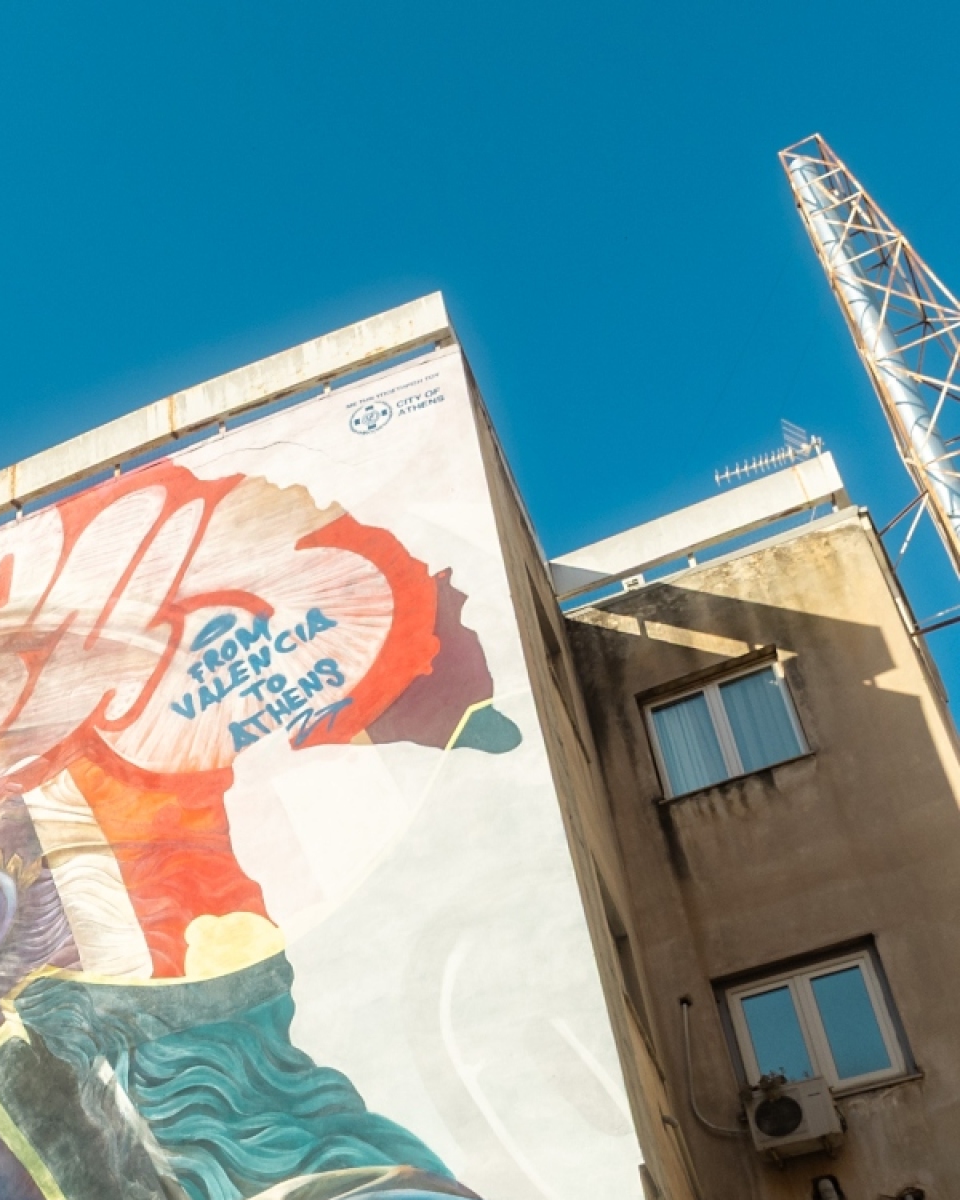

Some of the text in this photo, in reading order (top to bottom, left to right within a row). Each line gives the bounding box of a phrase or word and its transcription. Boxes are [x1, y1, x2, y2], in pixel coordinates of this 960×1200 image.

[396, 394, 421, 409] CITY
[398, 394, 445, 416] ATHENS
[170, 607, 339, 720] VALENCIA
[187, 612, 272, 683] FROM
[228, 658, 345, 753] ATHENS
[239, 673, 287, 702] TO
